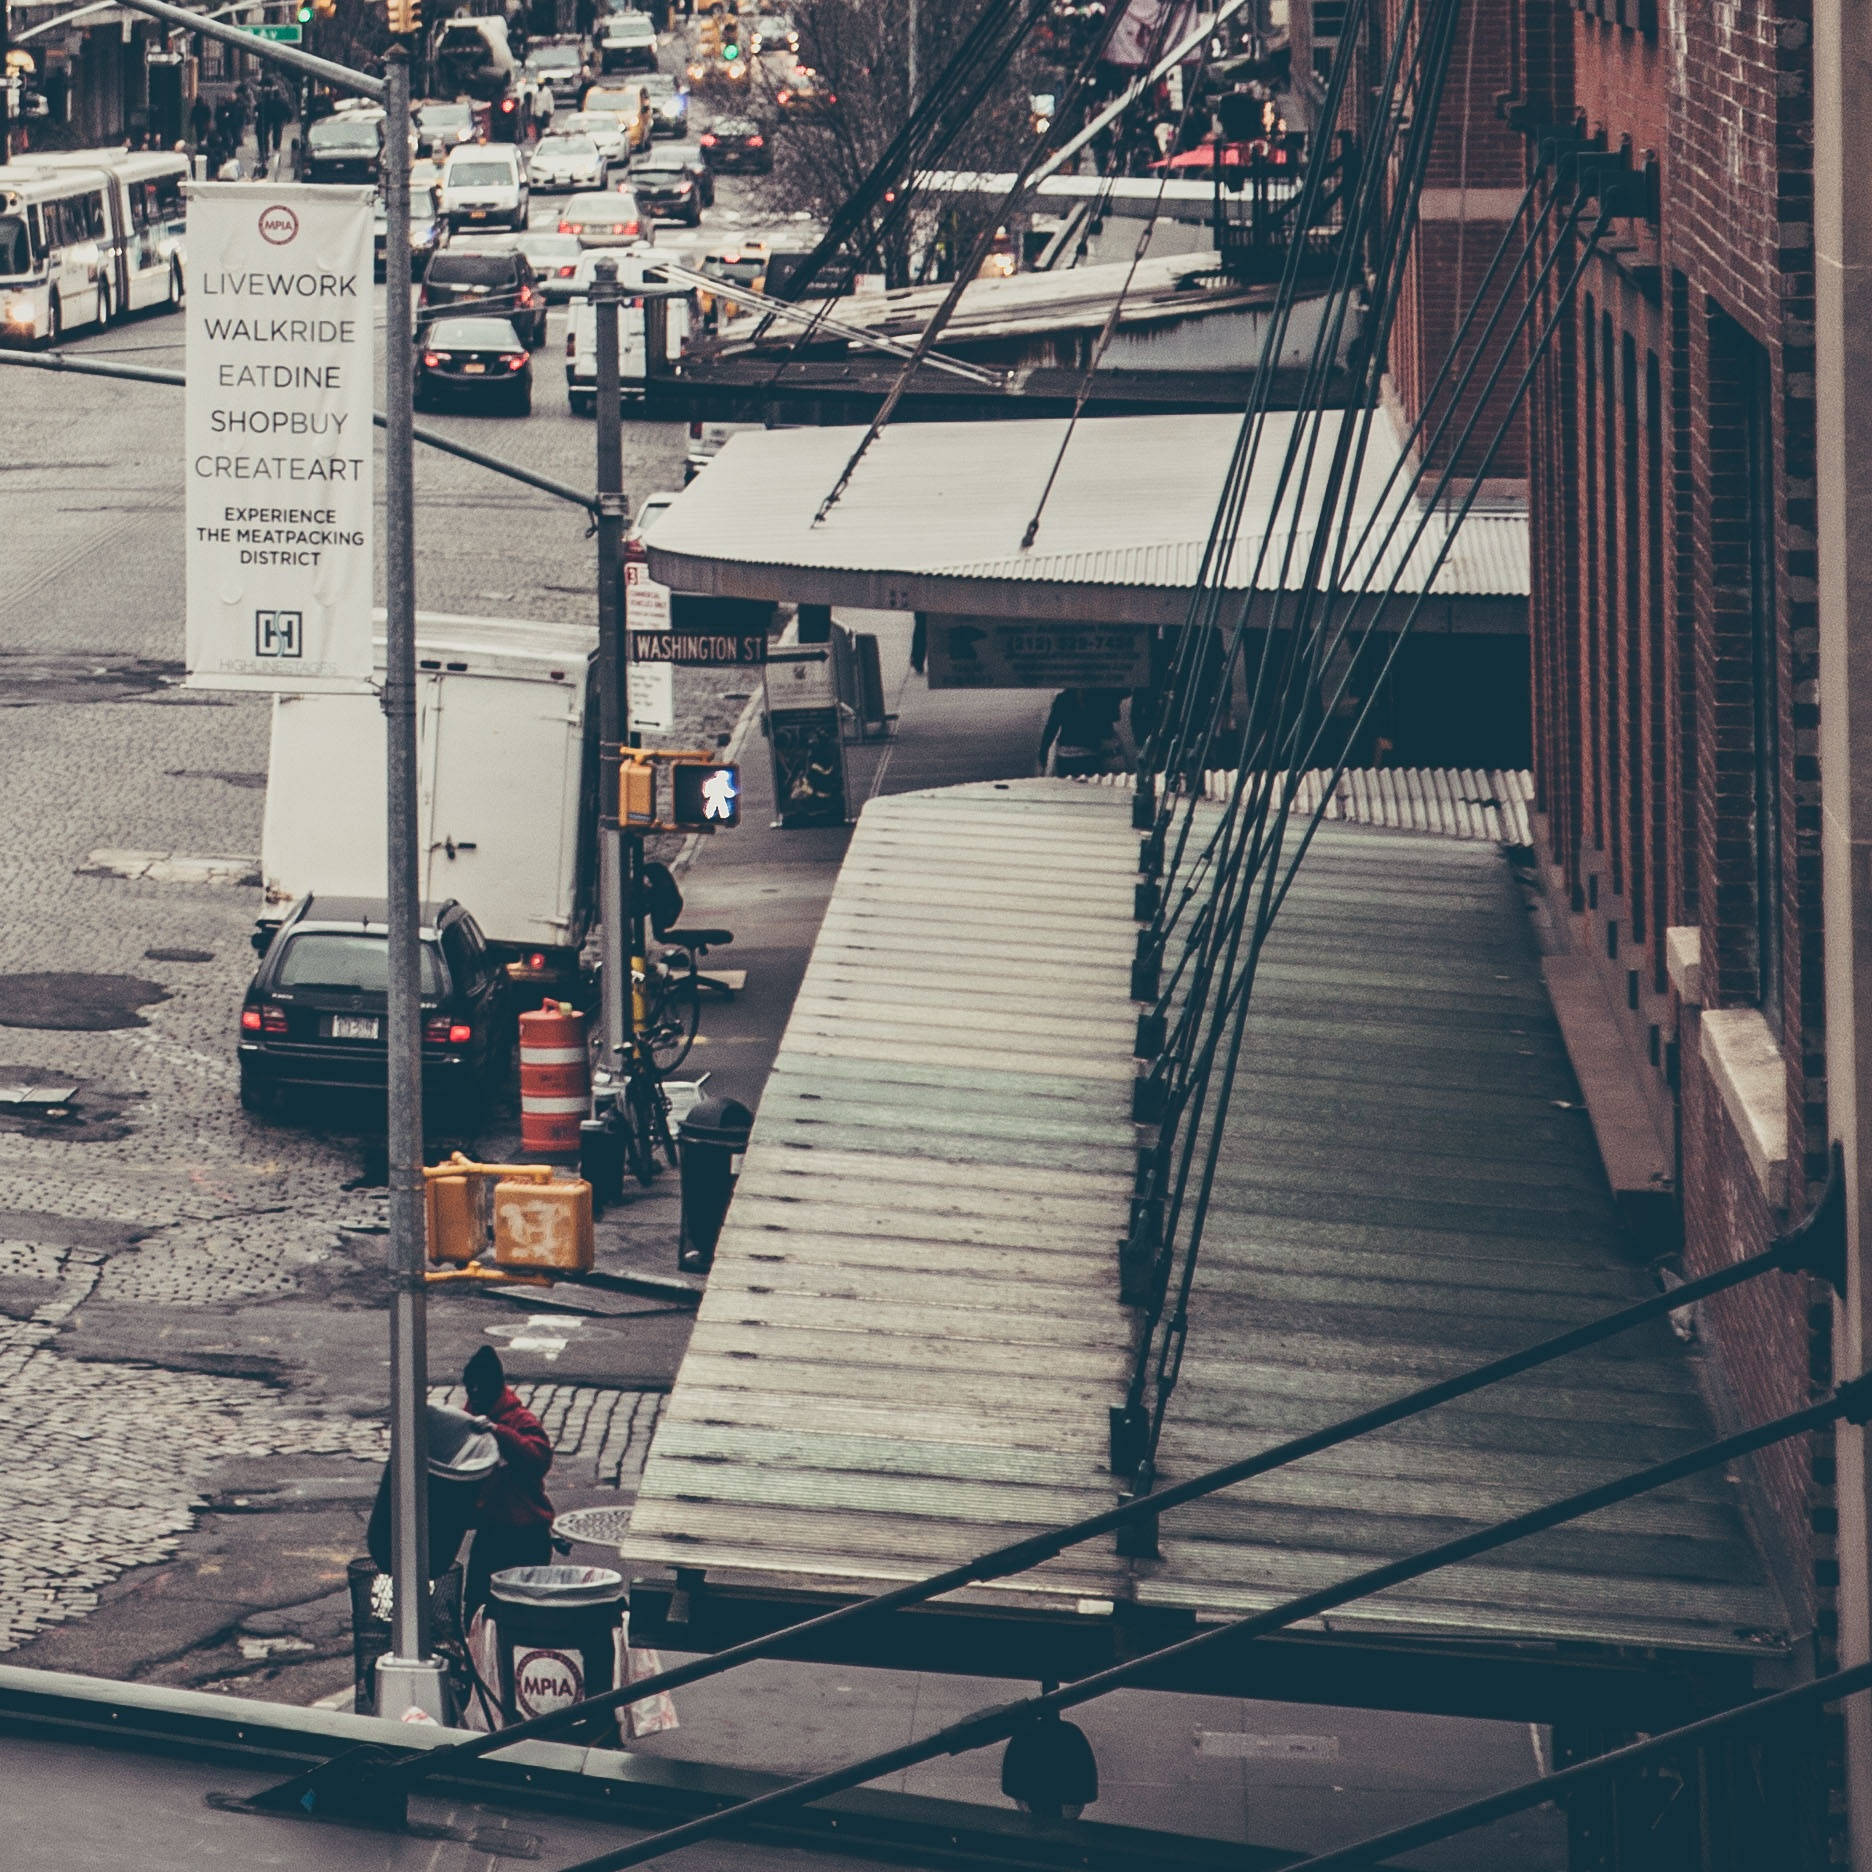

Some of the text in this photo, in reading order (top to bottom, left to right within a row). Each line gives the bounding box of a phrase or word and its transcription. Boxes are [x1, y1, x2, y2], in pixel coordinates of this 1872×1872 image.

[264, 220, 293, 231] MPIA
[203, 273, 357, 297] LIVEWORK
[204, 318, 355, 343] WALKRIDE
[219, 364, 341, 388] EATDINE
[211, 410, 348, 434] SHOPBUY
[195, 455, 364, 481] CREATEART
[224, 507, 337, 524] EXPERIENCE
[197, 527, 365, 546] THE MEATPACKING
[240, 550, 321, 566] DISTRICT
[636, 635, 763, 661] WASHINGTON ST
[524, 1675, 574, 1697] MPIA
